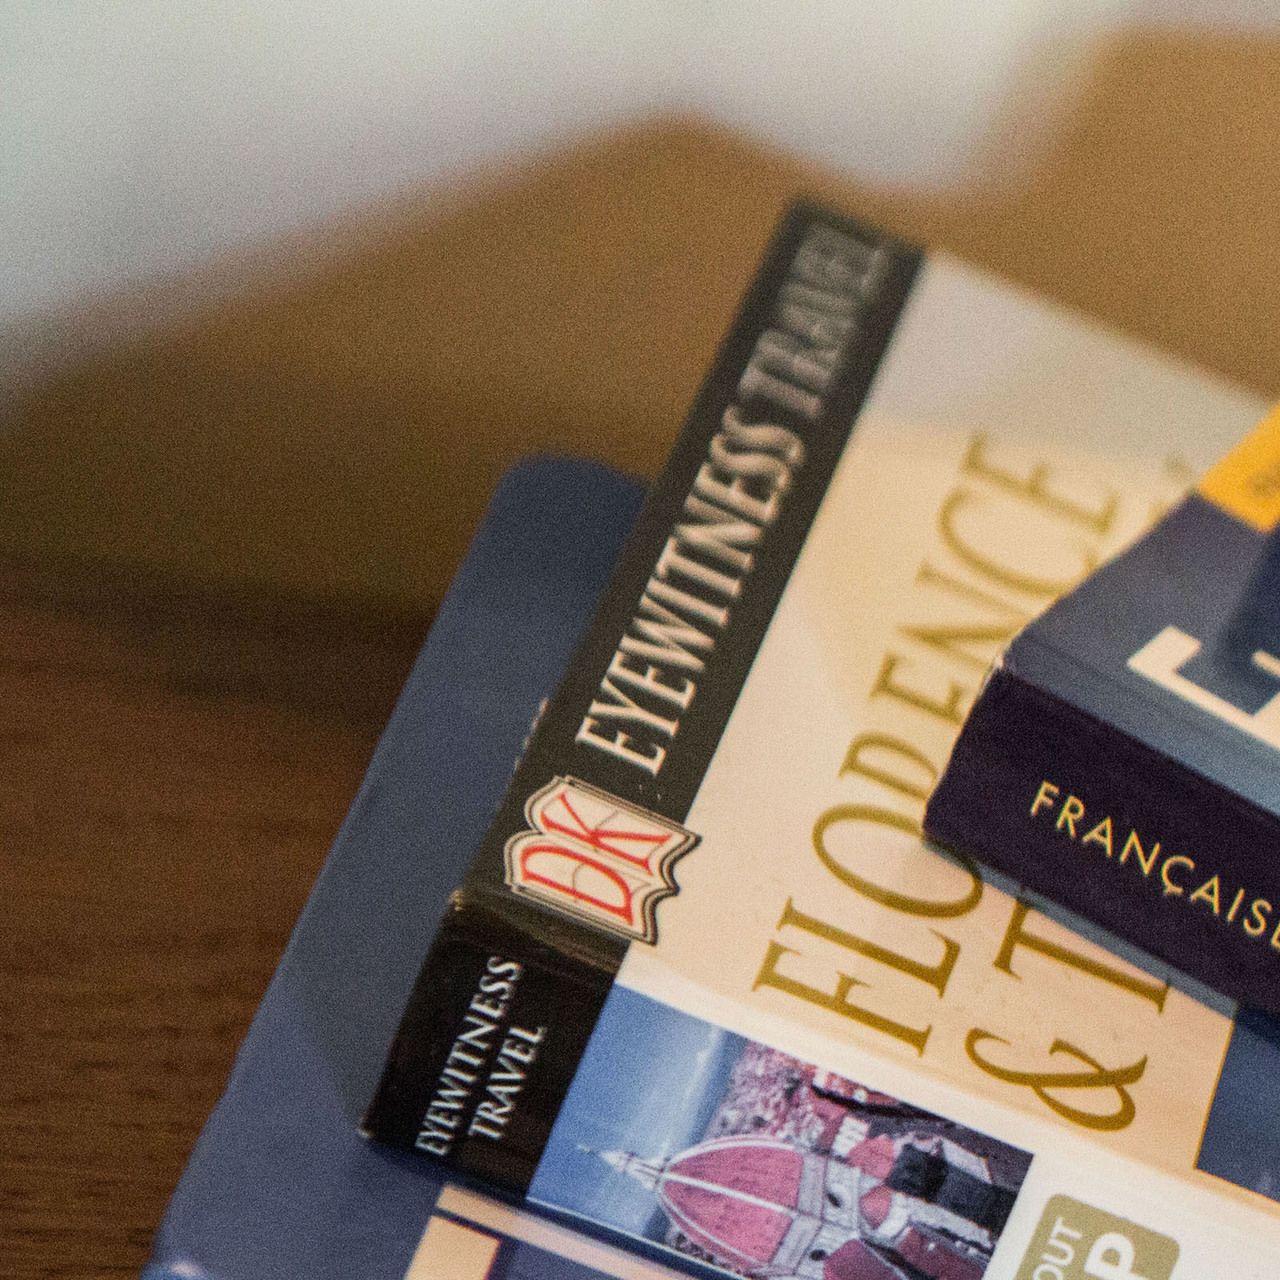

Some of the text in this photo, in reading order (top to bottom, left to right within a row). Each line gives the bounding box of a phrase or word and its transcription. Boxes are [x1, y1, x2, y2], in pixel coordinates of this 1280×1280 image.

[575, 403, 806, 776] EYEWITNESS
[519, 792, 674, 926] DK
[415, 955, 523, 1157] EYEWITNESS
[467, 1026, 547, 1140] TRAVEL
[965, 1027, 1150, 1132] &
